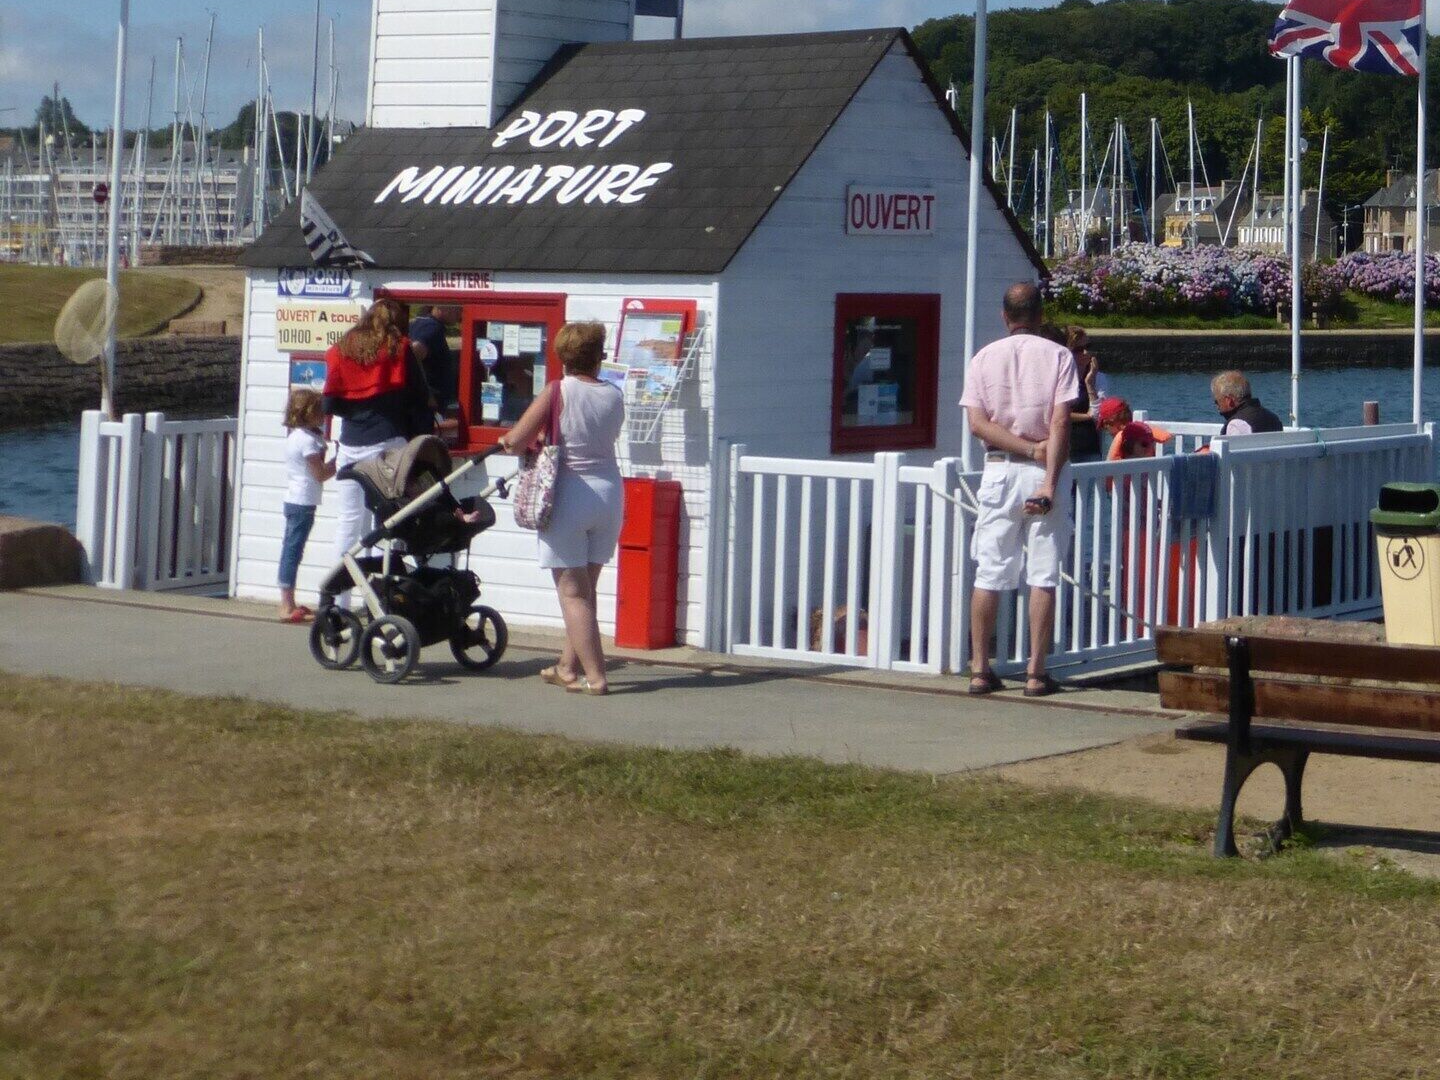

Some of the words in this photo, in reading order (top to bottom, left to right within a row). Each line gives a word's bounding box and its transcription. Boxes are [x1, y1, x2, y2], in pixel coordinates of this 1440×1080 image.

[492, 108, 646, 148] PORT
[374, 162, 673, 204] MINIATURE
[851, 193, 935, 230] OUVERT
[306, 268, 341, 284] PORT
[432, 271, 490, 288] BILLETTERIE
[276, 309, 316, 322] OUVERT
[331, 312, 359, 323] tous
[278, 328, 311, 344] 10H00
